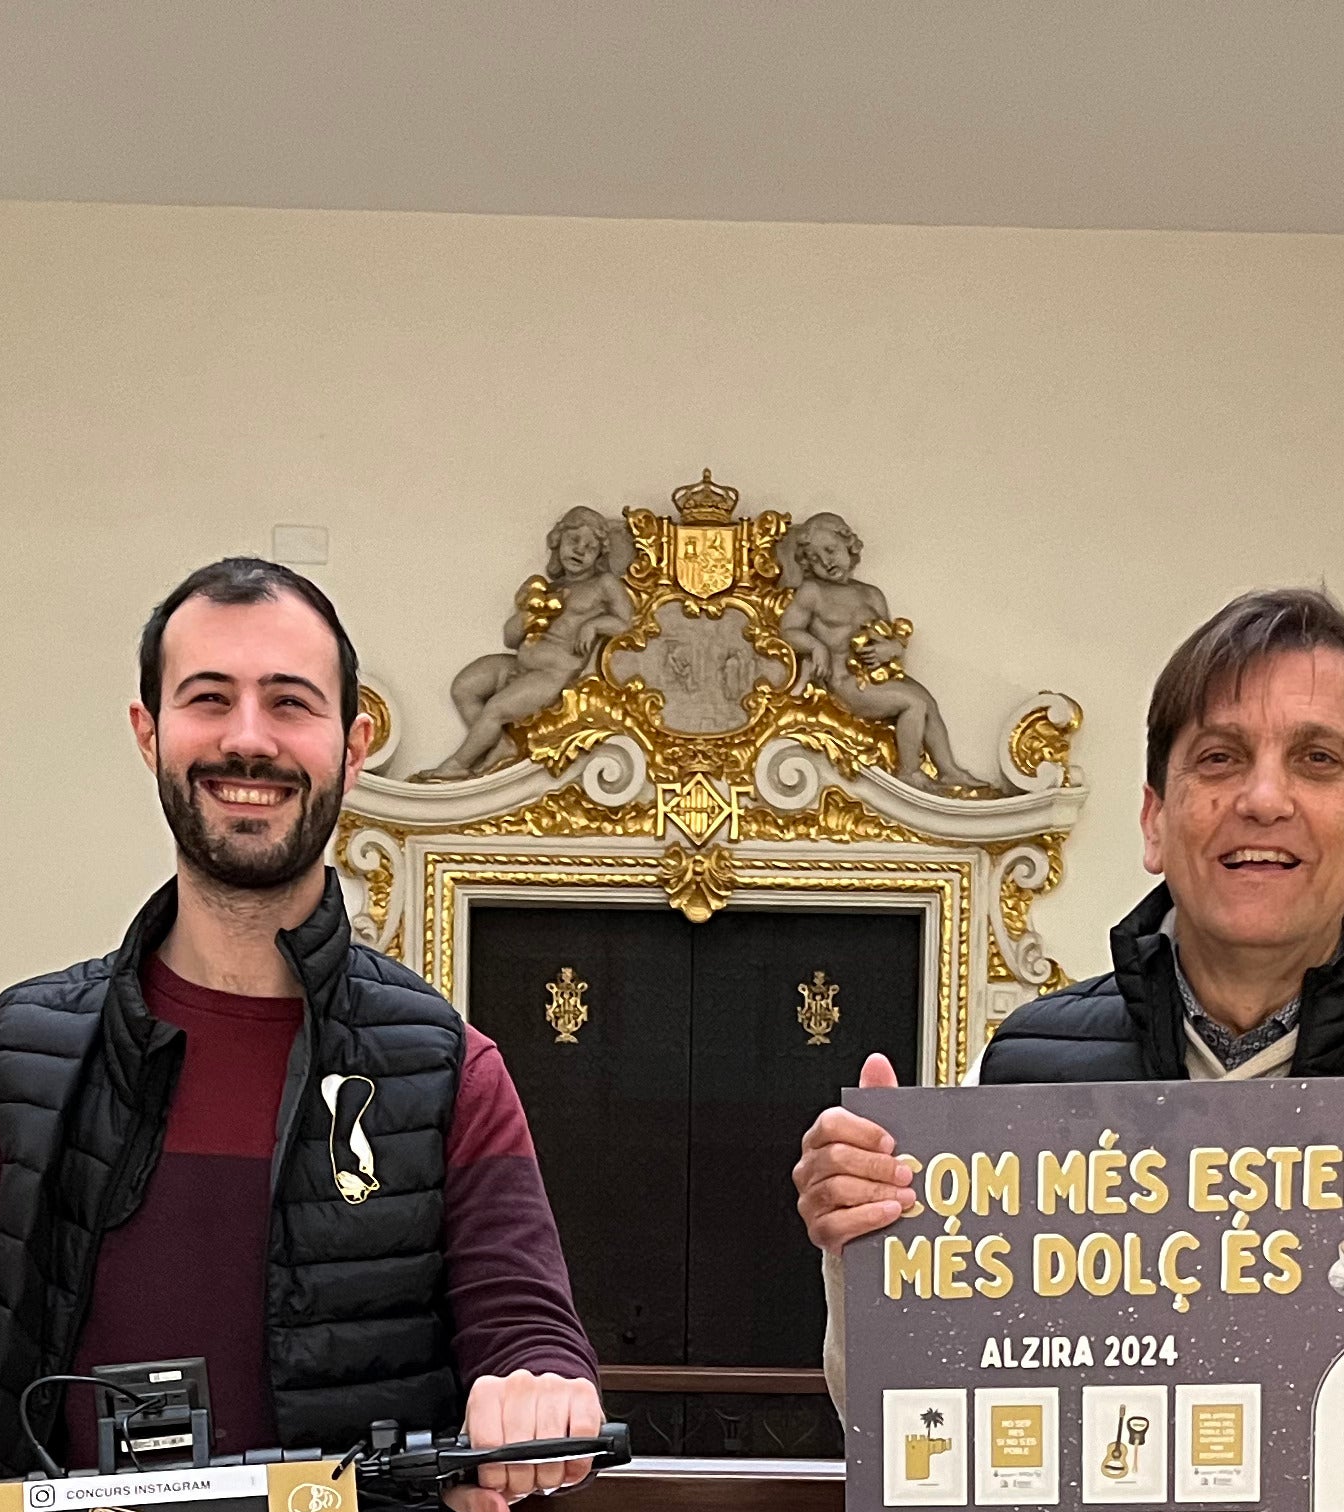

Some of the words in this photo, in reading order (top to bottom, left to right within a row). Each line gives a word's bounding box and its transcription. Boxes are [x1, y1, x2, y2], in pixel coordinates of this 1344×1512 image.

[1037, 1128, 1169, 1215] MÉS
[884, 1215, 1014, 1299] MÉS
[1033, 1231, 1201, 1313] DOLÇ
[1221, 1210, 1302, 1294] ÉS
[980, 1336, 1094, 1368] ALZIRA
[1104, 1335, 1178, 1367] 2024
[66, 1486, 131, 1500] CONCURS
[134, 1481, 211, 1495] INSTAGRAM
